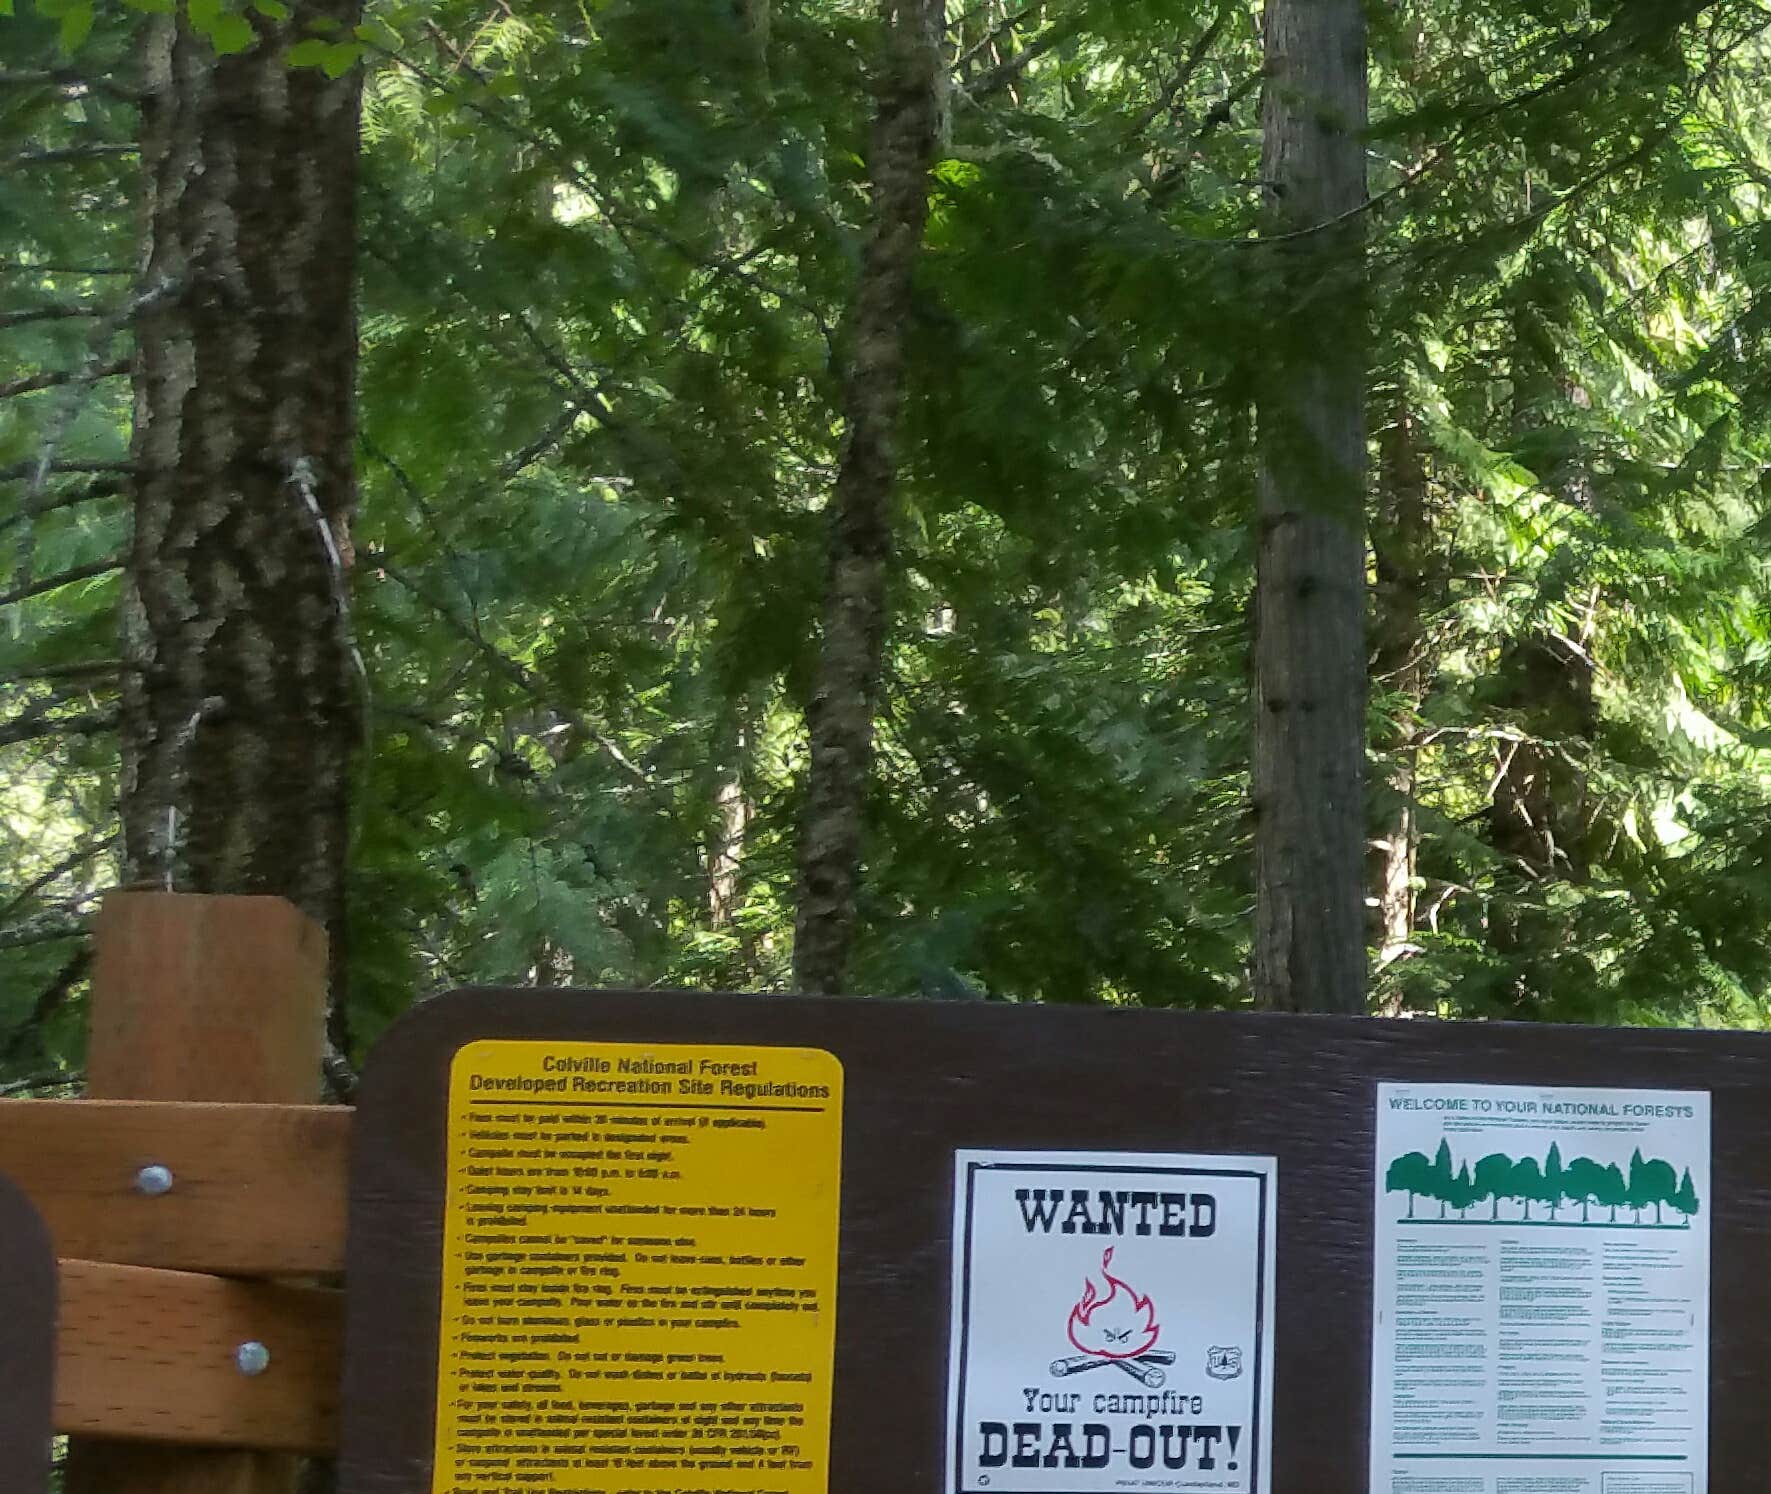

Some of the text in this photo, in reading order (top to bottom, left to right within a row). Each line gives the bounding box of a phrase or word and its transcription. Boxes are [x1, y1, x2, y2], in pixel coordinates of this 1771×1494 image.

[544, 1056, 757, 1075] Colville National Forest
[470, 1075, 829, 1099] Developed Recreation Site Regulations
[1390, 1098, 1694, 1118] WELCOME TO YOUR NATIONAL FORESTS
[1015, 1189, 1217, 1237] WANTED
[1023, 1388, 1203, 1419] Your campfire
[979, 1422, 1241, 1470] DEAD-OUT!
